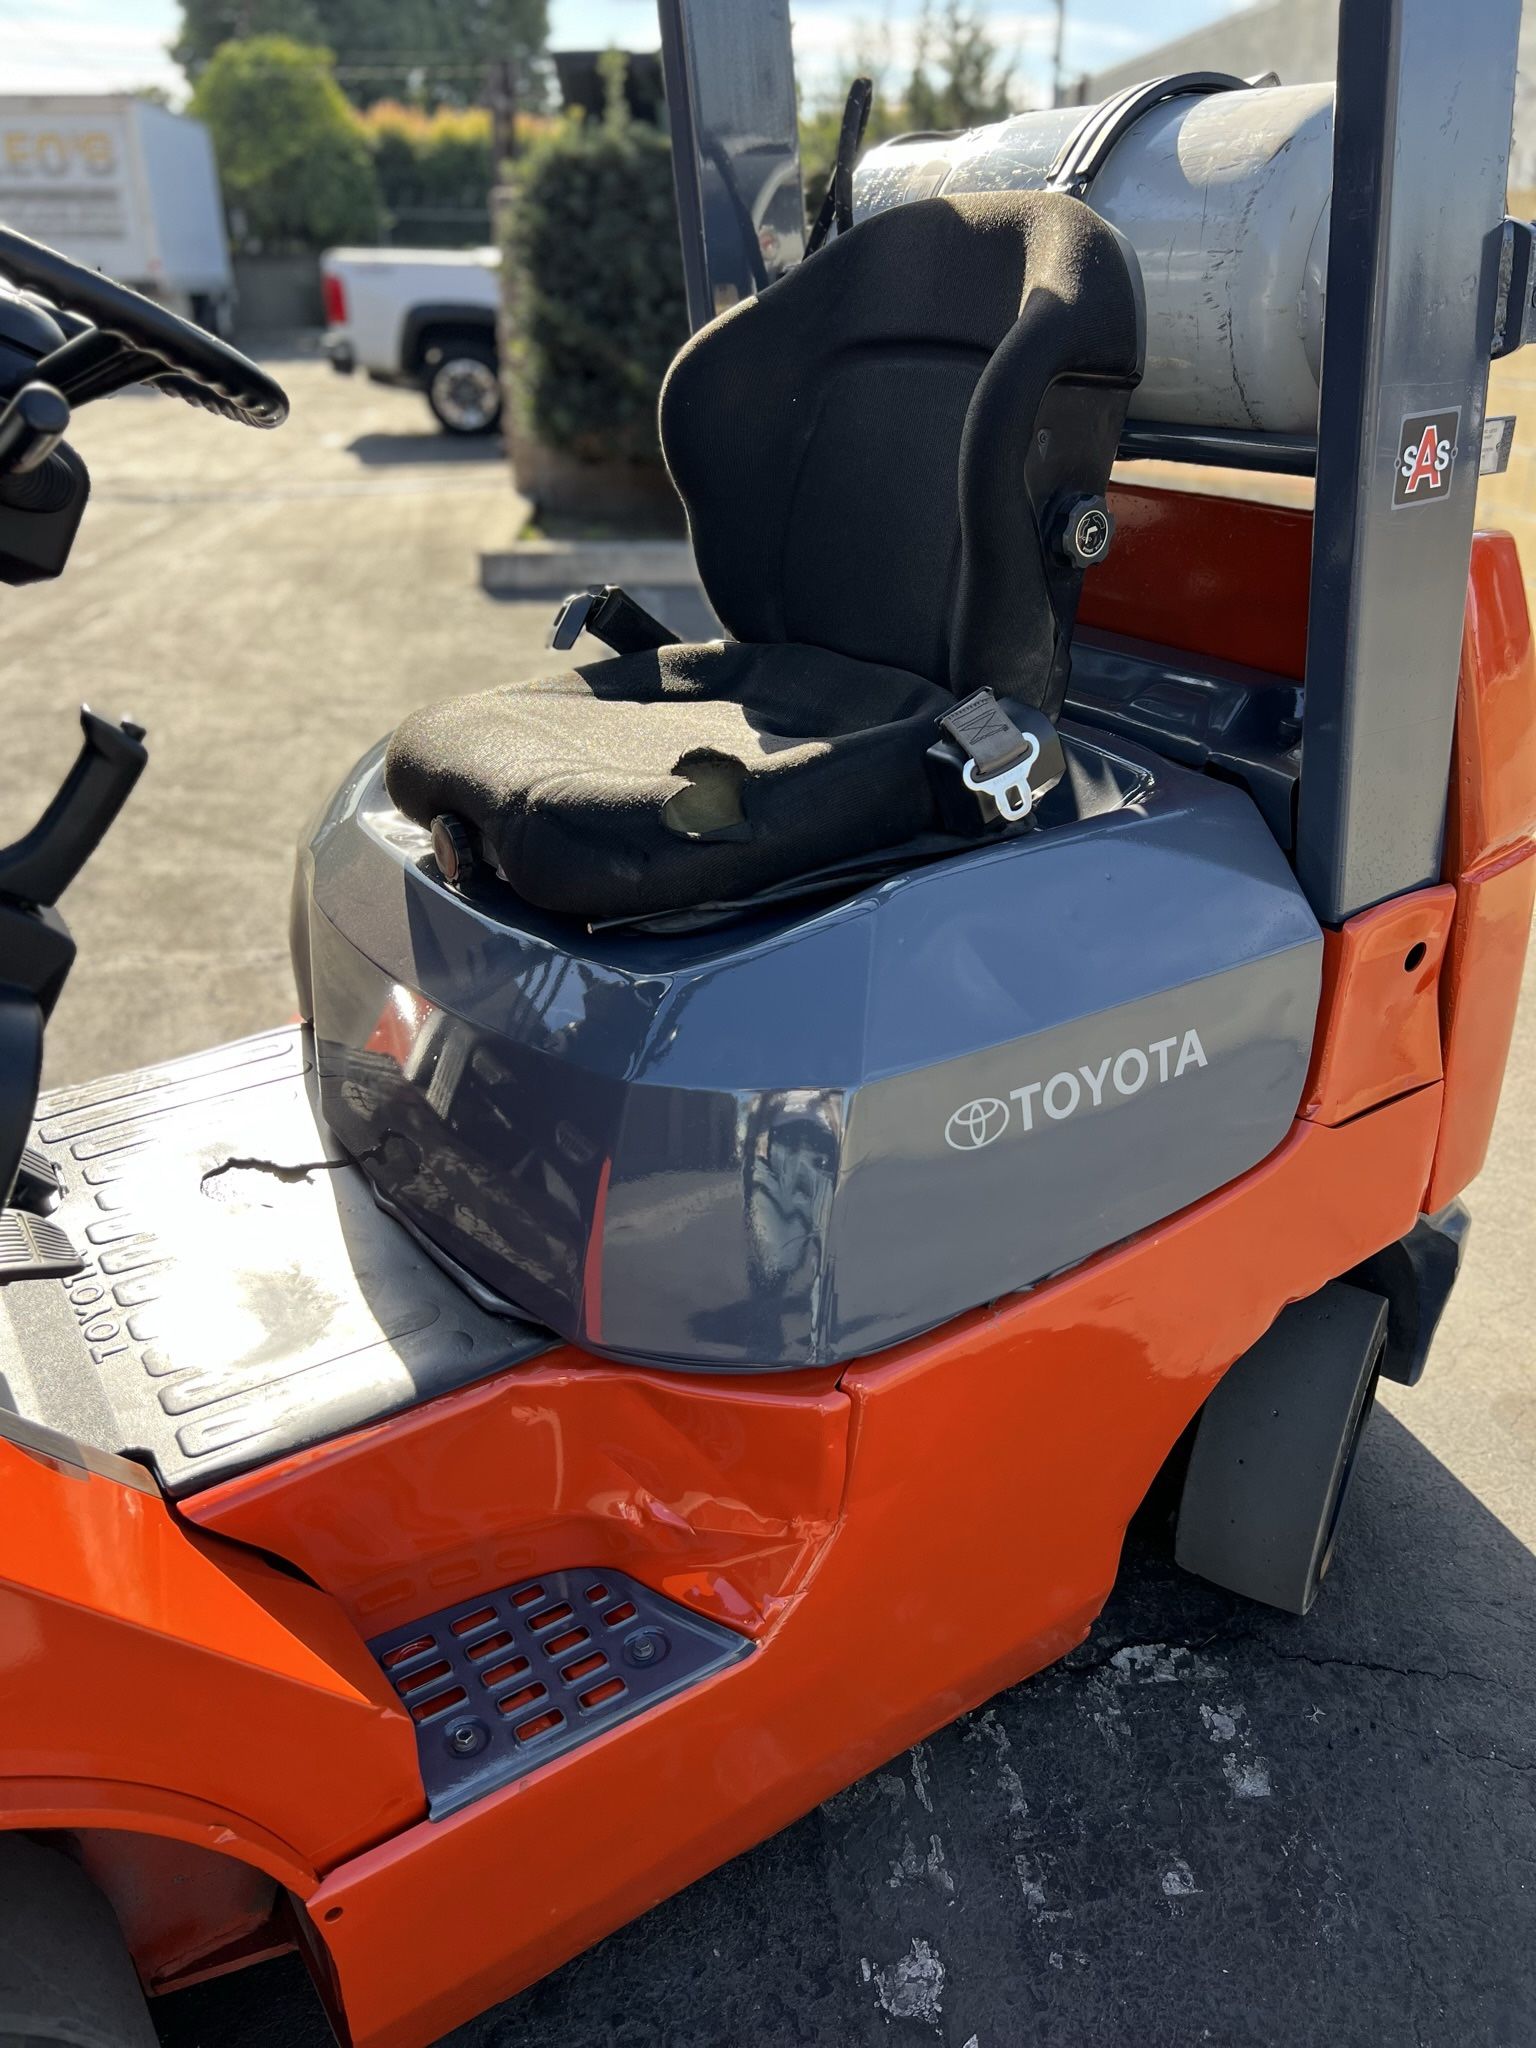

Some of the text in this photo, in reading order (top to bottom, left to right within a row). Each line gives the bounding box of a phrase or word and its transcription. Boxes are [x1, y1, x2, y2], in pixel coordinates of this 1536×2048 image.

[0, 129, 114, 178] EO'S
[1401, 425, 1451, 494] SAS
[1010, 1028, 1208, 1131] TOYOTA
[62, 1249, 129, 1365] TOYOT
